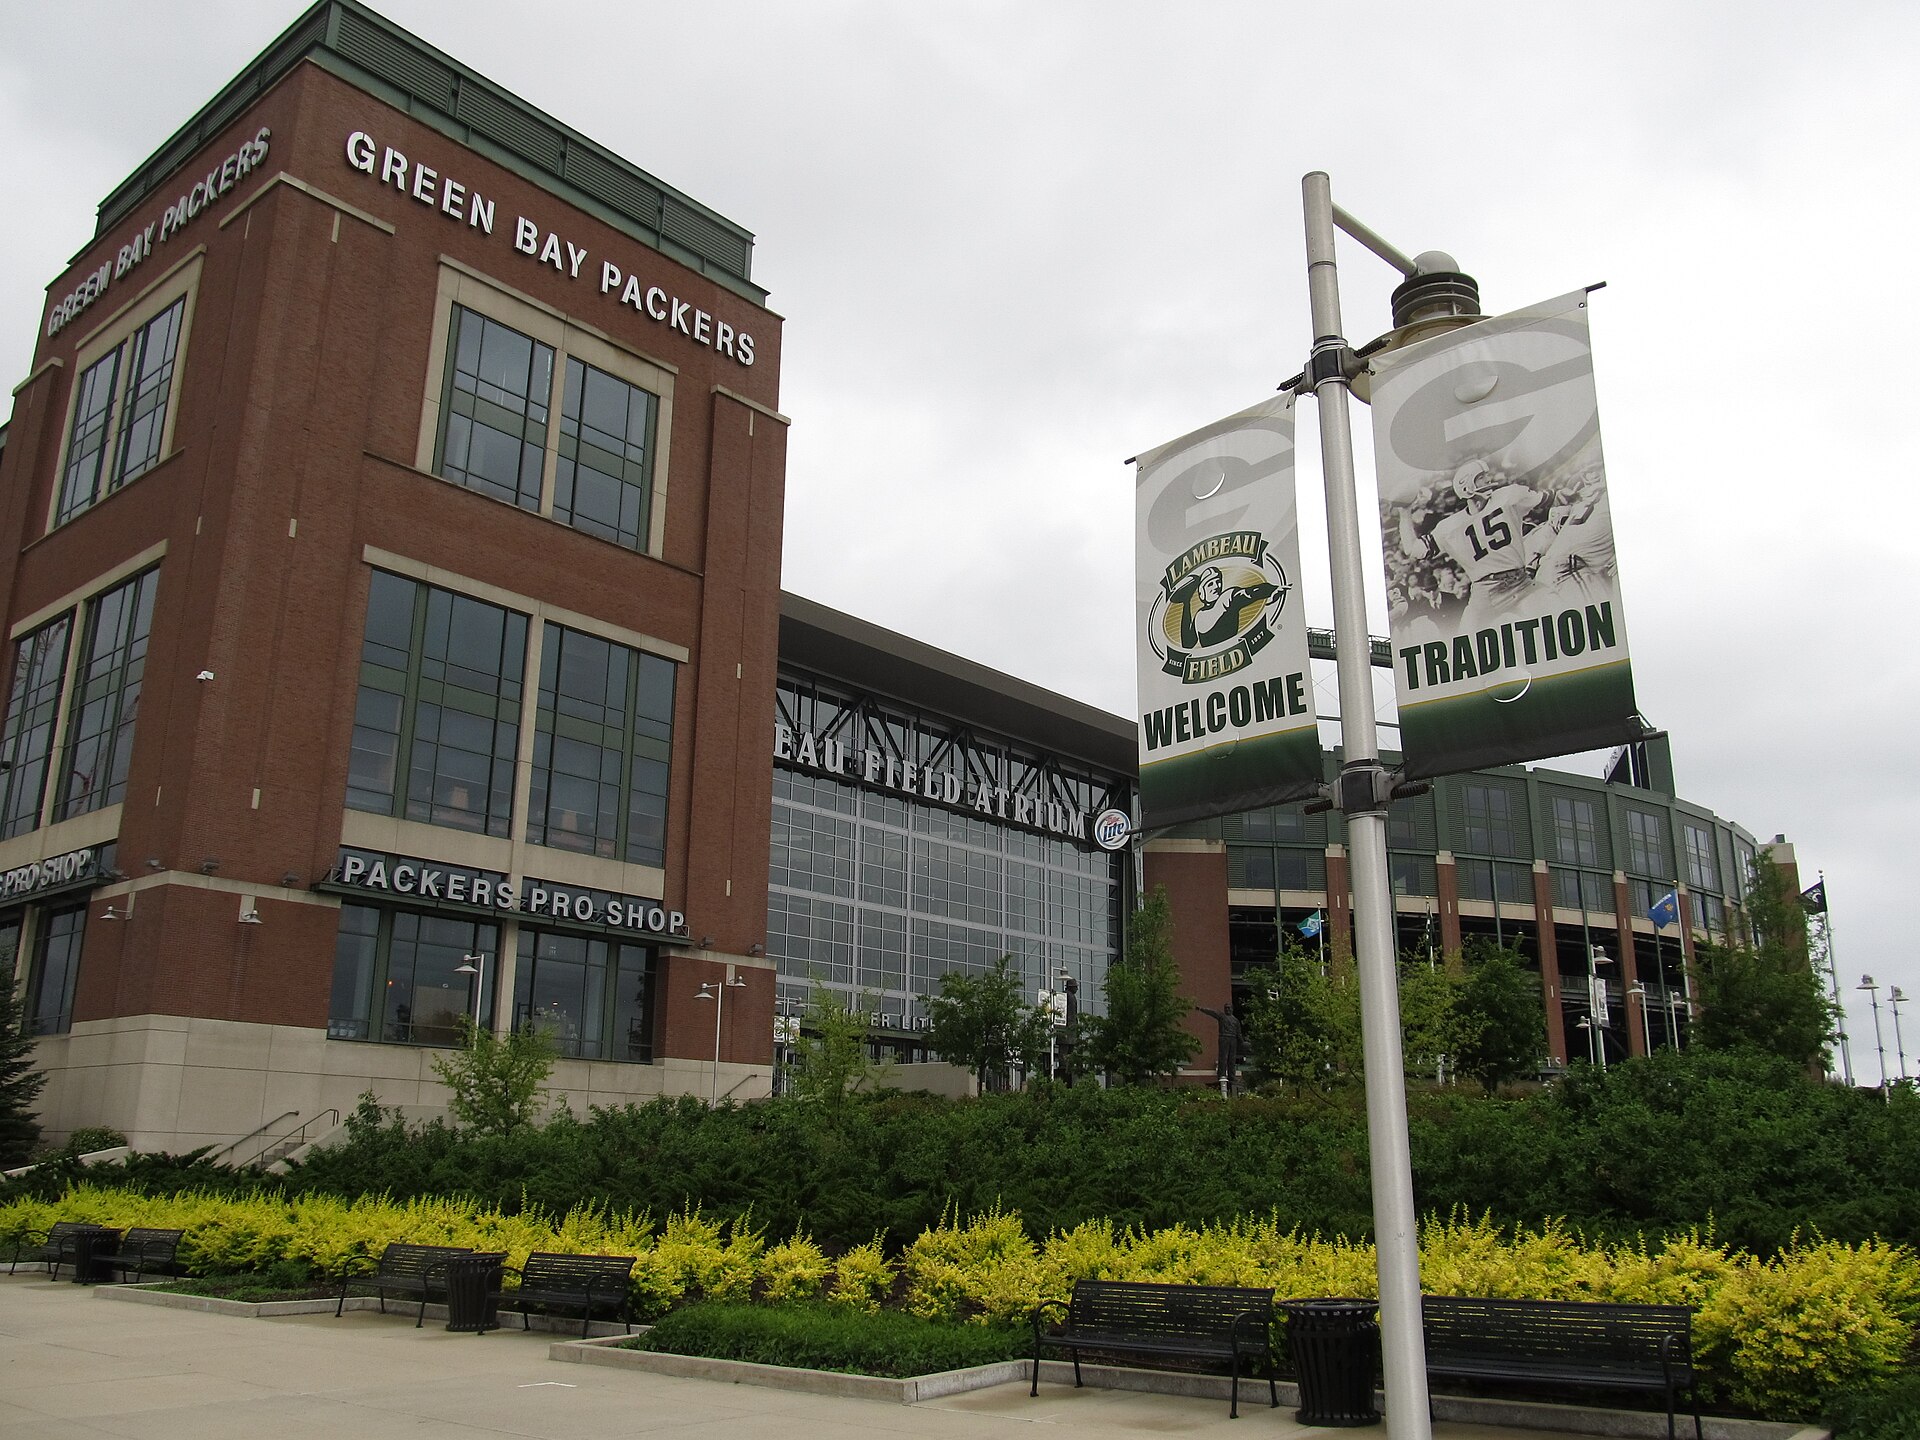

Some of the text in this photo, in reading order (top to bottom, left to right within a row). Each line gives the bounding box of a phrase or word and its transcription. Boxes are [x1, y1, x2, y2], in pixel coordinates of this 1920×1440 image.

[48, 126, 271, 337] GREEN BAY PACKERS
[346, 131, 756, 367] GREEN BAY PACKERS
[1169, 534, 1257, 584] LAMBEAU
[1464, 507, 1512, 562] 15
[1187, 648, 1245, 681] FIELD
[1400, 601, 1617, 691] TRADITION
[1143, 671, 1308, 752] WELCOME
[864, 748, 961, 805] FIELD
[974, 783, 1087, 840] ATRIUM
[5, 864, 40, 896] PRO
[40, 849, 92, 887] SHOP
[343, 855, 686, 935] PACKERS PRO SHOP
